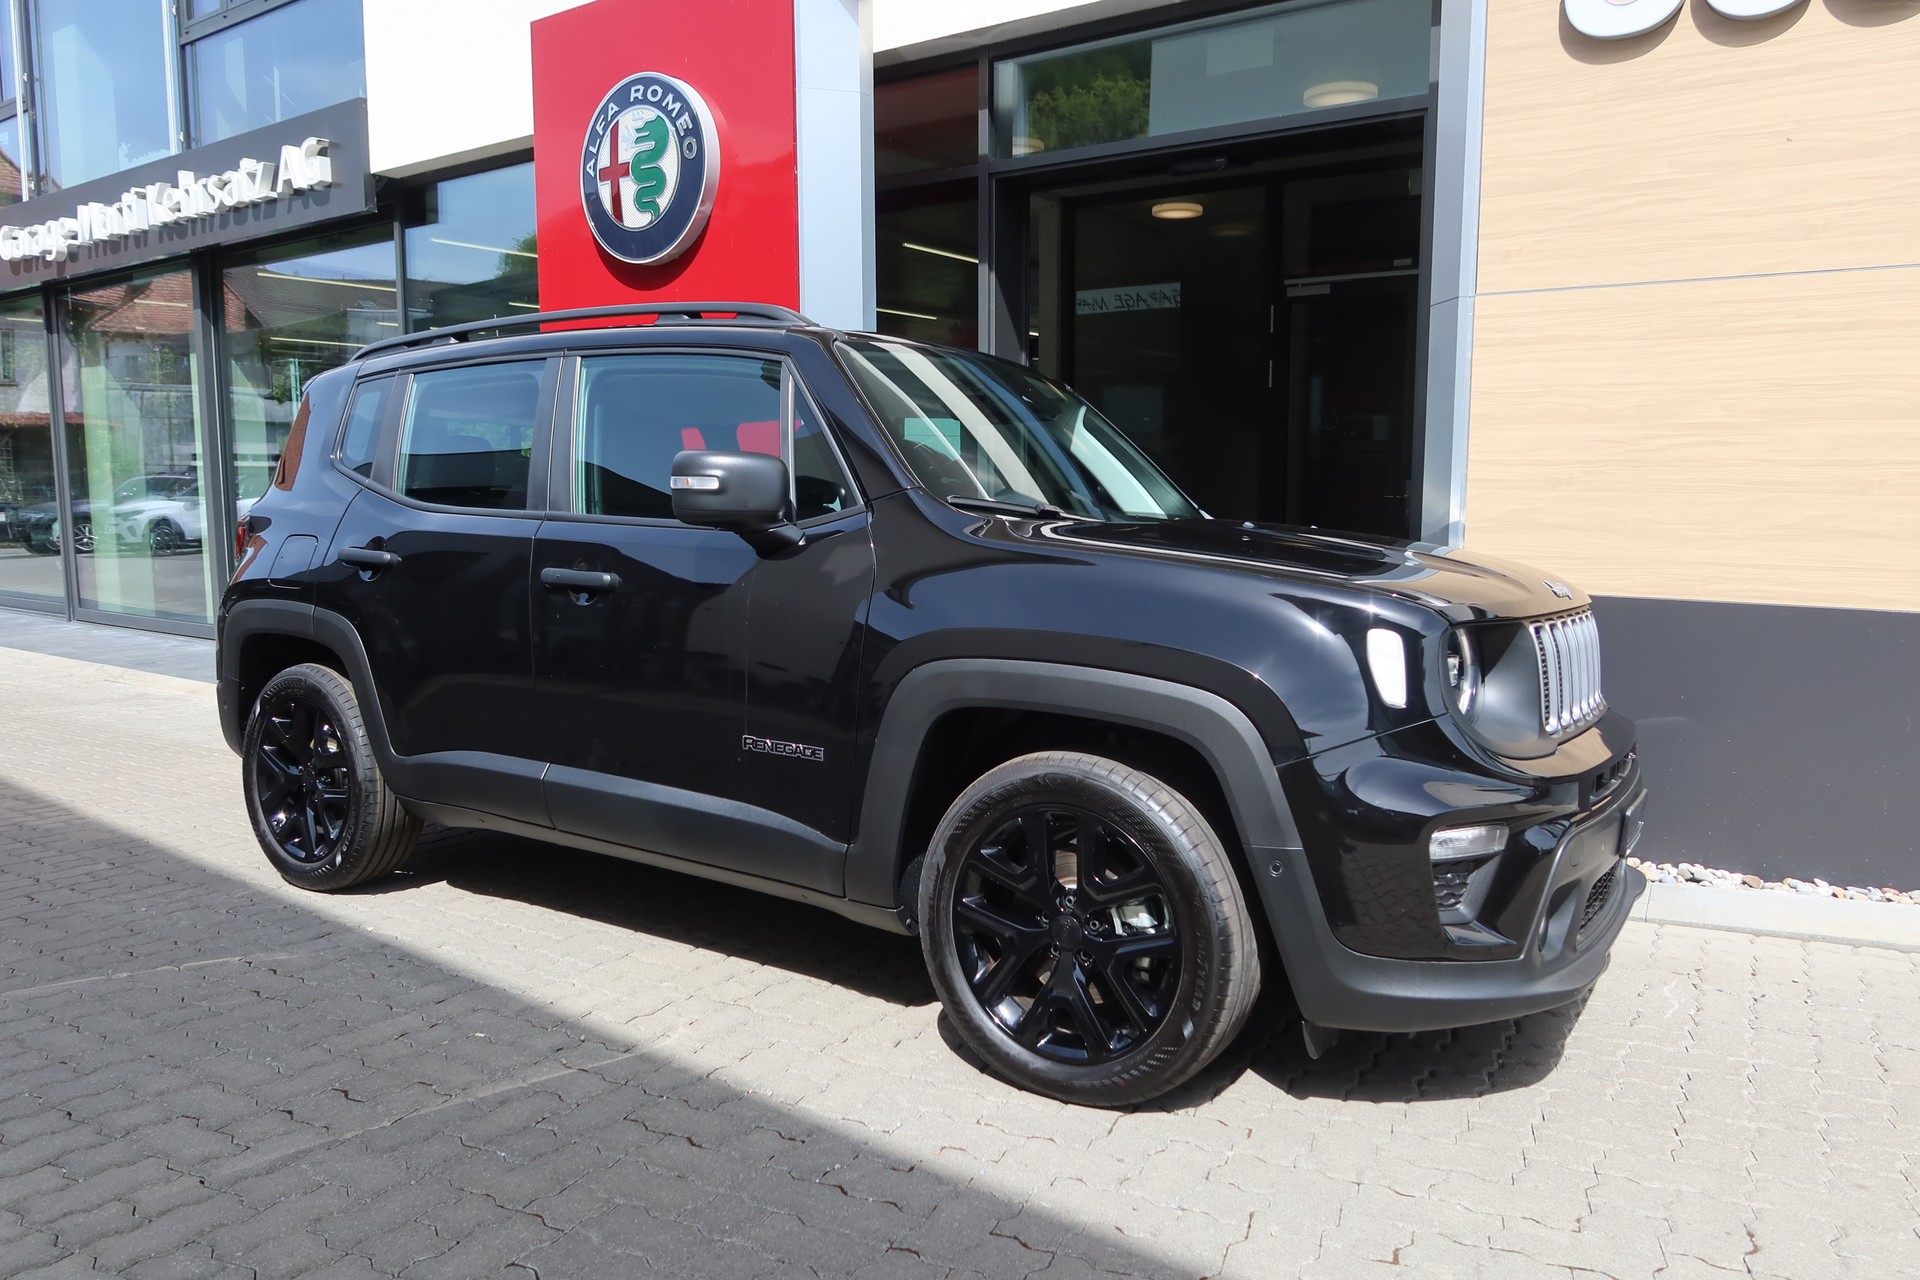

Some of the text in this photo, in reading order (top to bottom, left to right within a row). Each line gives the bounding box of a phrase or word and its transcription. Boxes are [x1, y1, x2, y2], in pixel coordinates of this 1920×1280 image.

[586, 84, 698, 177] ALFA ROMEO
[0, 217, 80, 262] Garage
[277, 136, 332, 197] AG
[742, 735, 824, 761] RENEGADE
